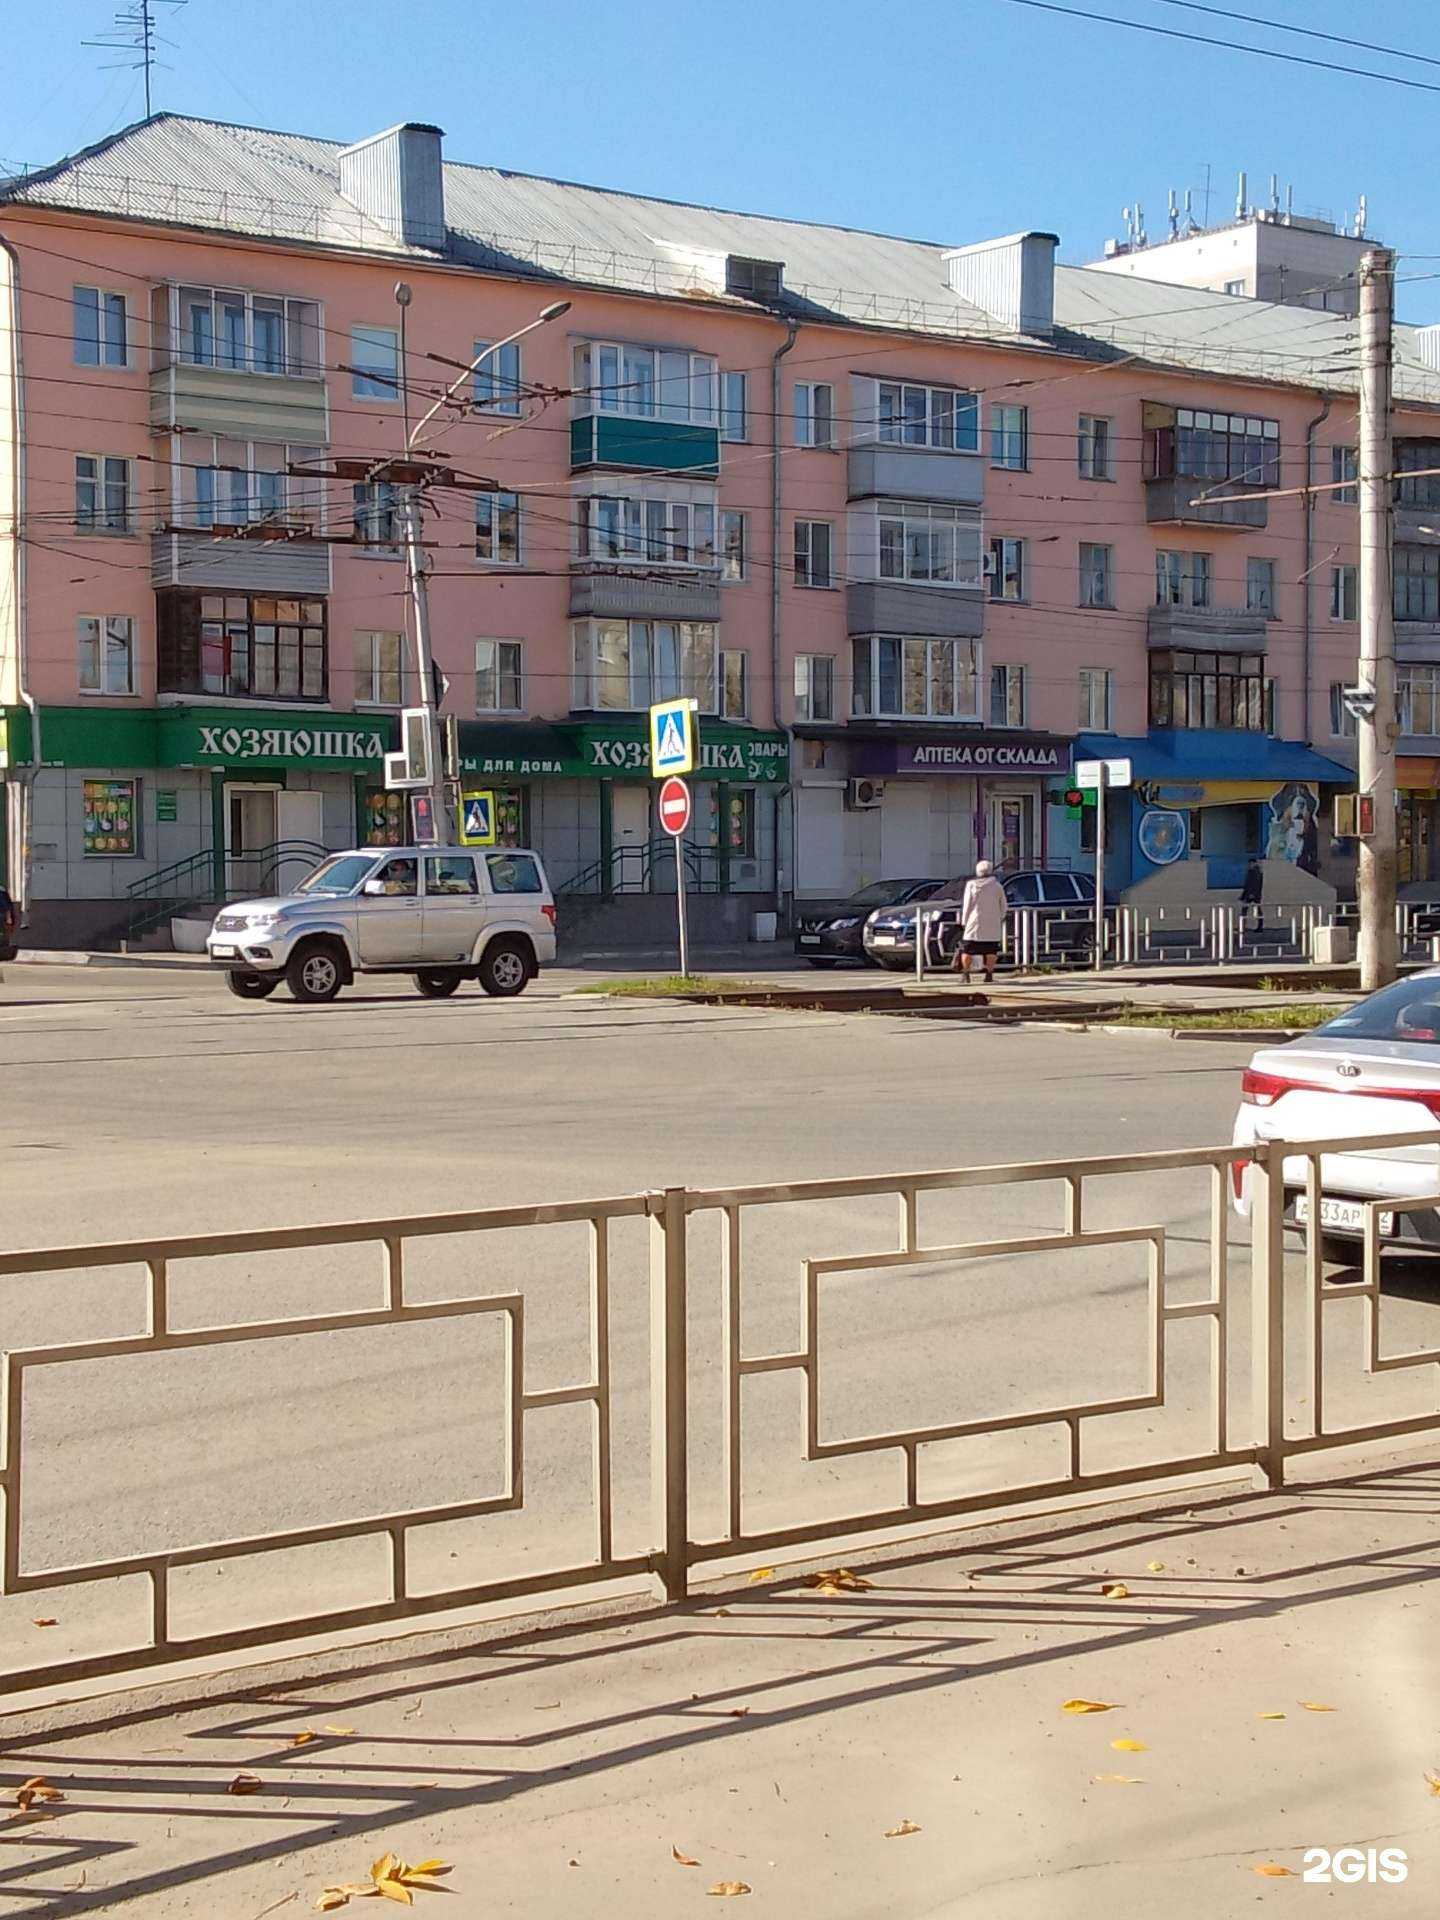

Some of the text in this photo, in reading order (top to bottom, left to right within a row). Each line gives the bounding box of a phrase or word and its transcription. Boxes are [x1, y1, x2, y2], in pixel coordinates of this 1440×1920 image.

[198, 727, 384, 759] ХОЗЯЮШКА
[590, 741, 746, 769] ХОЗКА
[913, 745, 1058, 765] АПТЕКА ОТ СКЛАДА
[483, 759, 515, 773] ДЛЯ
[520, 760, 563, 774] ДОМА
